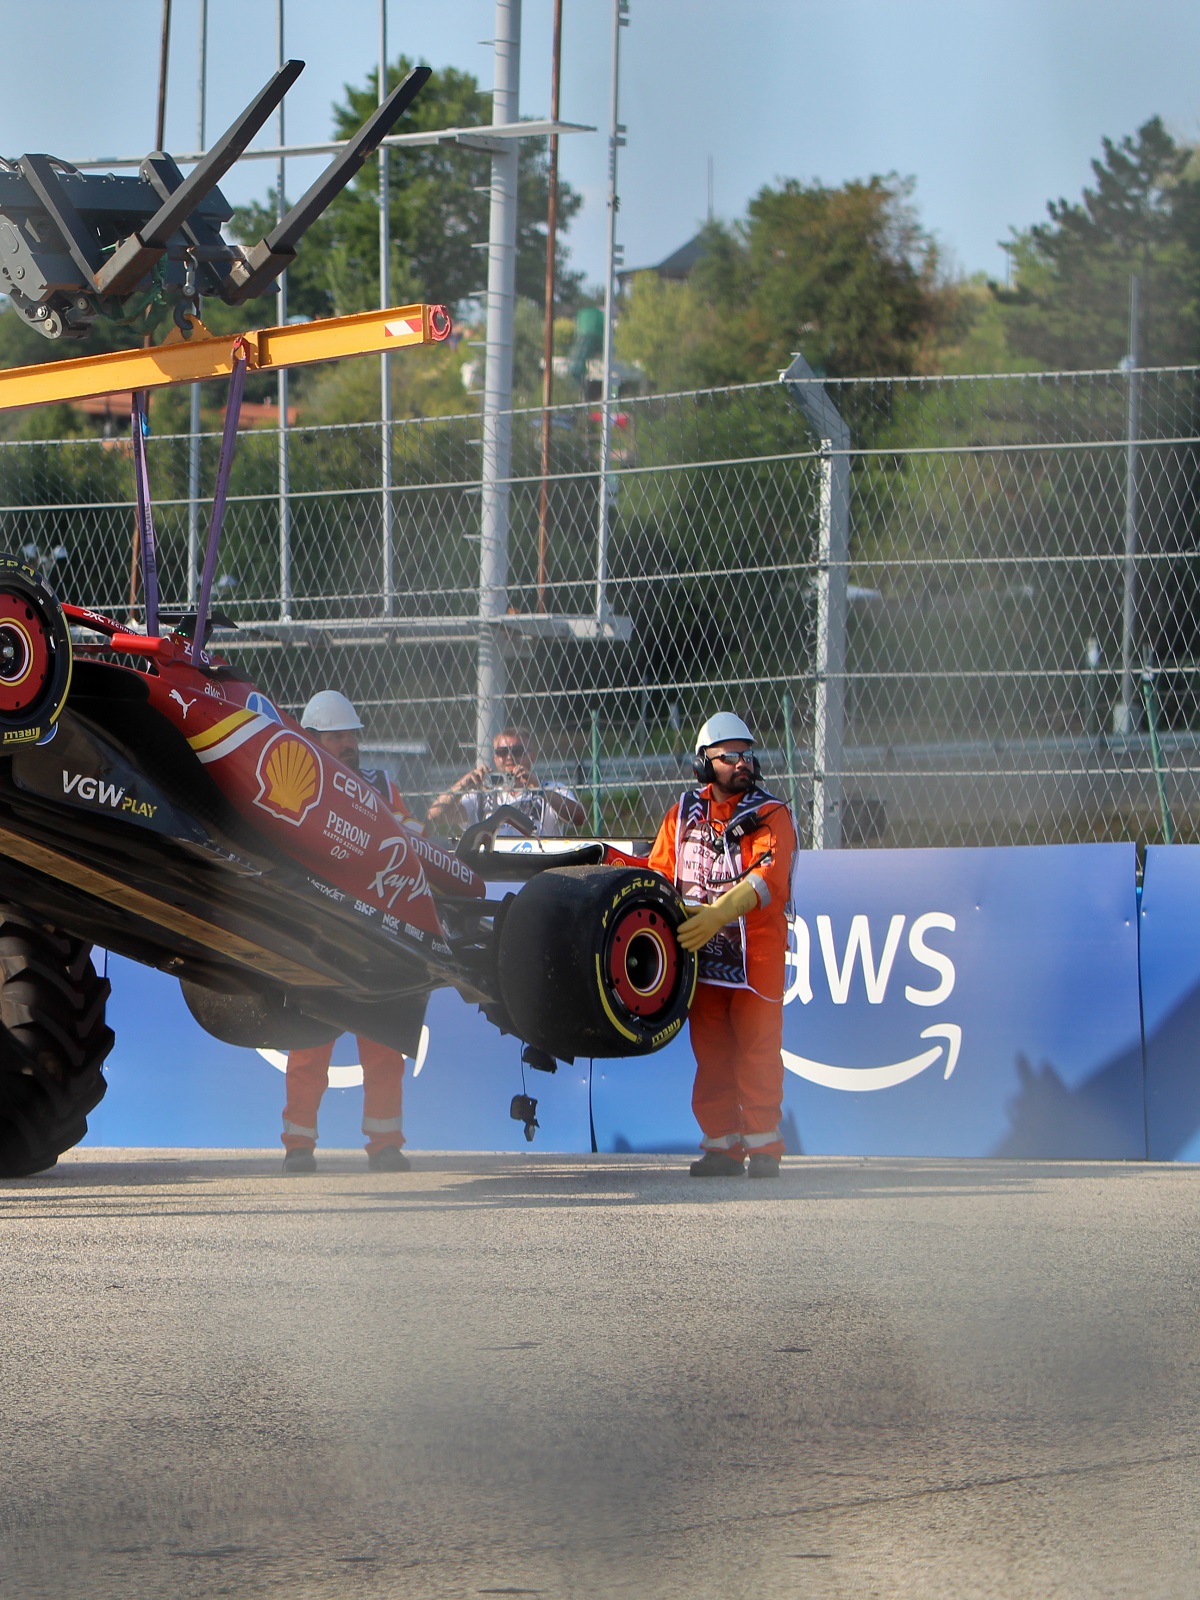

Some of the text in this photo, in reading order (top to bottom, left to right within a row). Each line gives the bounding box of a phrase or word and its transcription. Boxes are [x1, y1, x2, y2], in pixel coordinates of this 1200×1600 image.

[83, 610, 143, 637] DXC TECHNOL
[63, 769, 158, 818] VGW PLAY
[351, 802, 377, 822] LOGISTICS
[326, 810, 371, 849] PERONI
[411, 836, 475, 886] antander
[353, 900, 377, 916] SKF
[382, 913, 401, 930] NGK
[431, 938, 453, 955] brem
[783, 912, 956, 1006] aws
